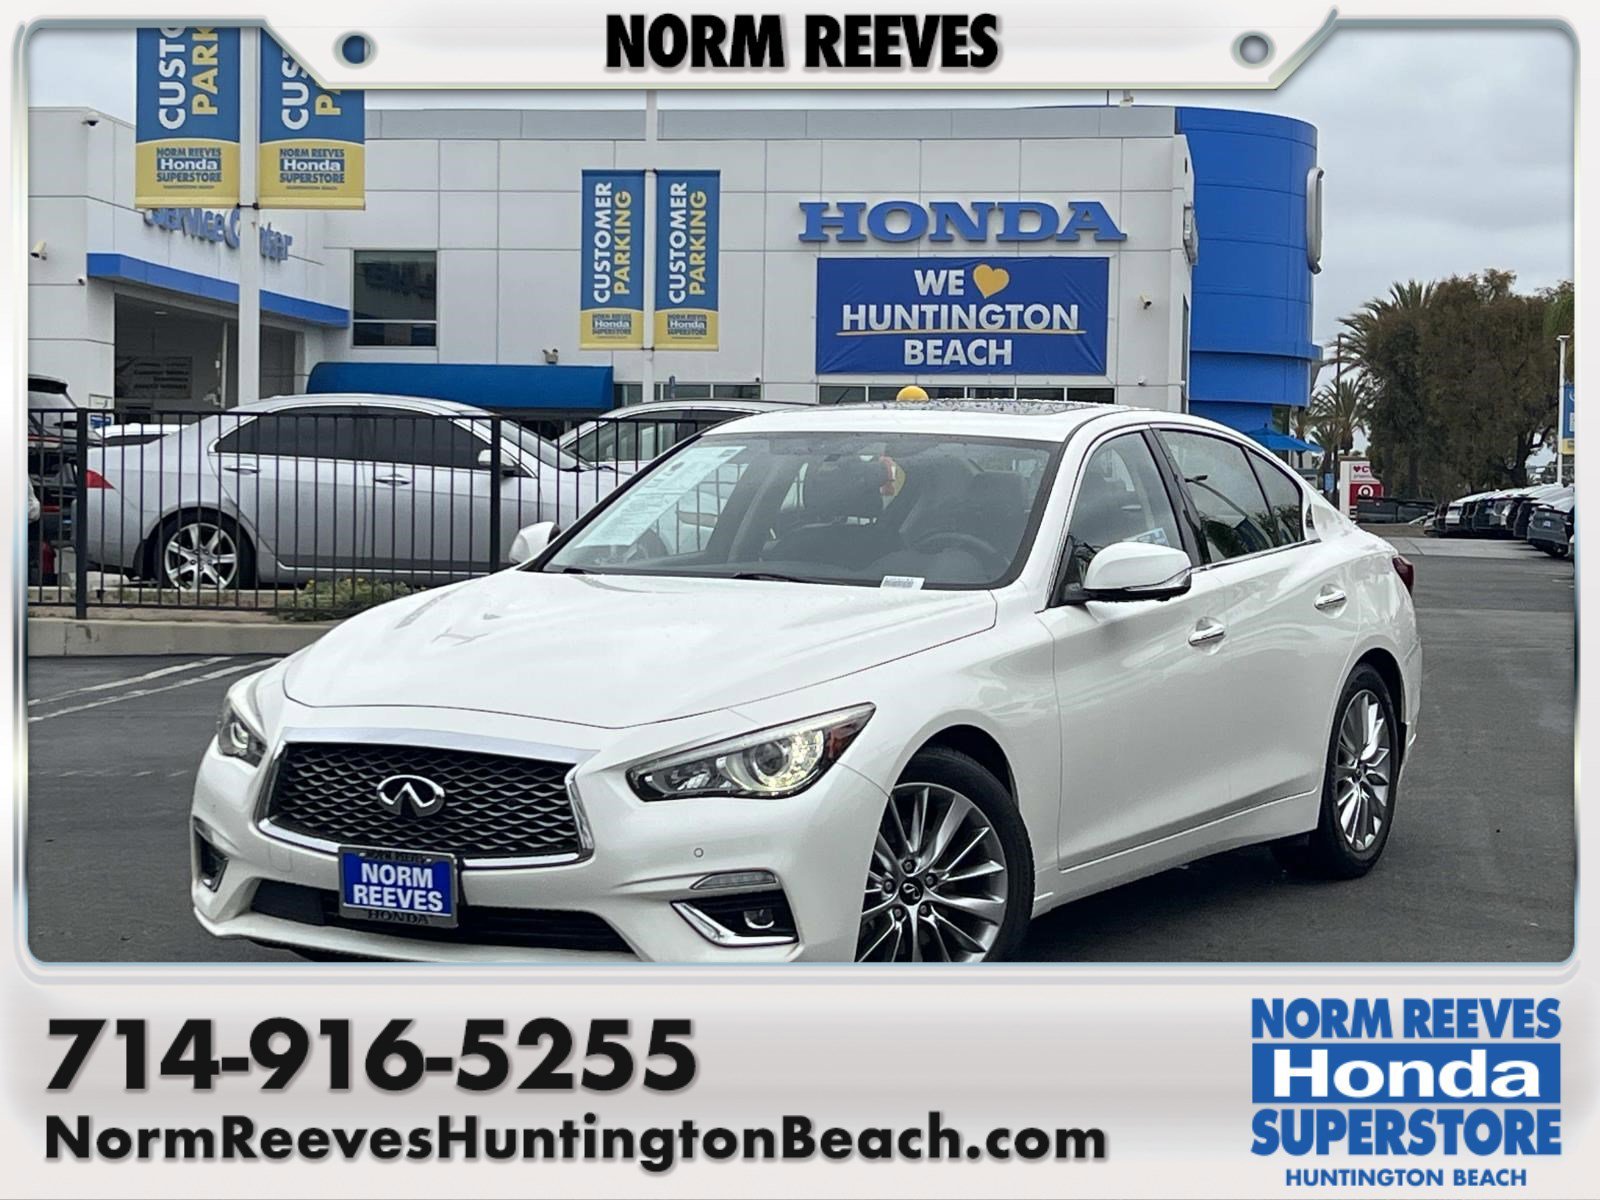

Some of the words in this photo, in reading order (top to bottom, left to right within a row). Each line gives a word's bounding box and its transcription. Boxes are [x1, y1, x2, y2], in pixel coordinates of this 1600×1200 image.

[156, 172, 222, 183] SUPERSTORE
[161, 158, 218, 170] Honda
[283, 159, 341, 171] Honda
[280, 173, 345, 184] SUPERSTORE
[799, 200, 1128, 243] HONDA
[593, 182, 612, 304] CUSTOMER
[614, 190, 632, 296] PARKING
[668, 182, 687, 304] CUSTOMER
[688, 190, 707, 296] PARKING
[914, 269, 965, 296] WE
[842, 303, 1079, 331] HUNTINGTON
[903, 338, 1013, 366] BEACH
[361, 862, 434, 889] NORM
[353, 884, 444, 912] REEVES
[367, 909, 430, 925] HONDA
